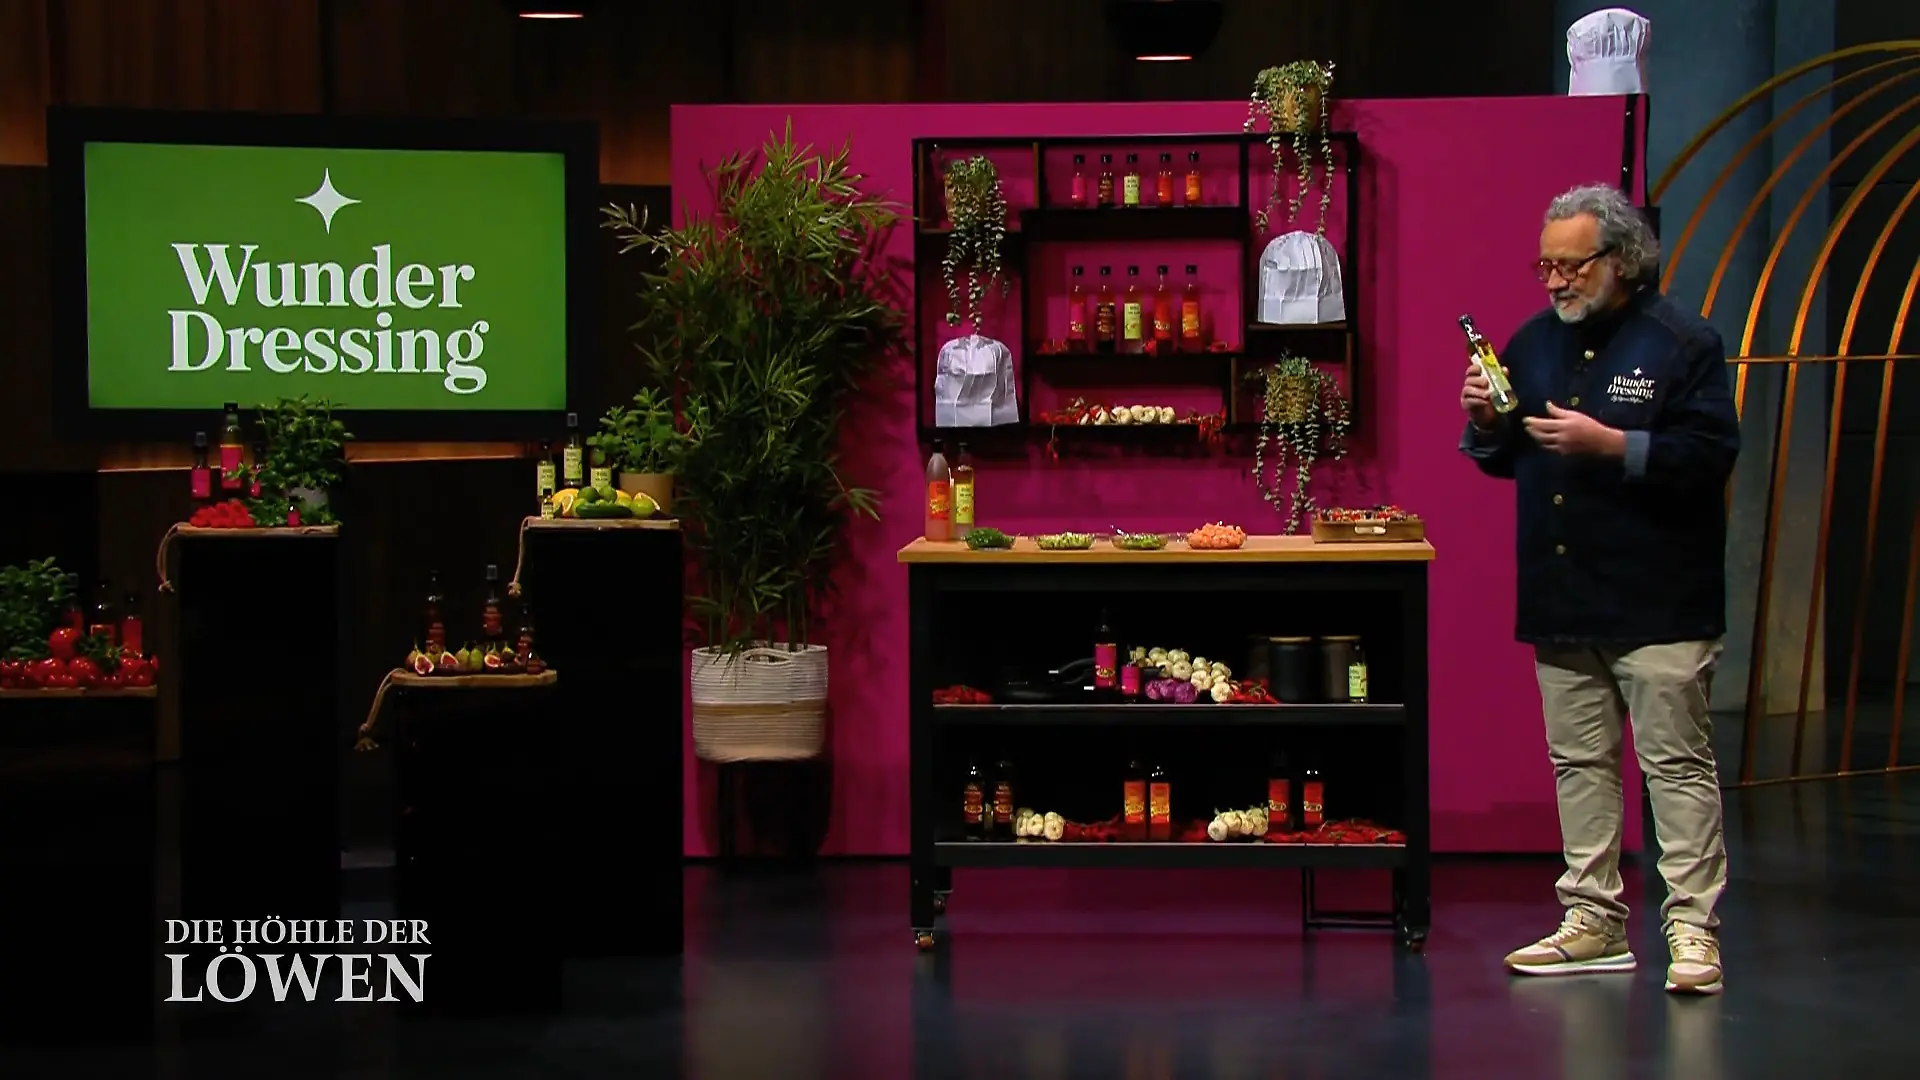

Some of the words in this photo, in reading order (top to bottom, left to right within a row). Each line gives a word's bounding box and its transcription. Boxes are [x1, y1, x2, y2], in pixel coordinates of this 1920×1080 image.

[171, 243, 475, 309] Wunder
[167, 311, 490, 394] Dressing
[1606, 384, 1655, 399] Dressing
[1612, 375, 1655, 388] Wunder
